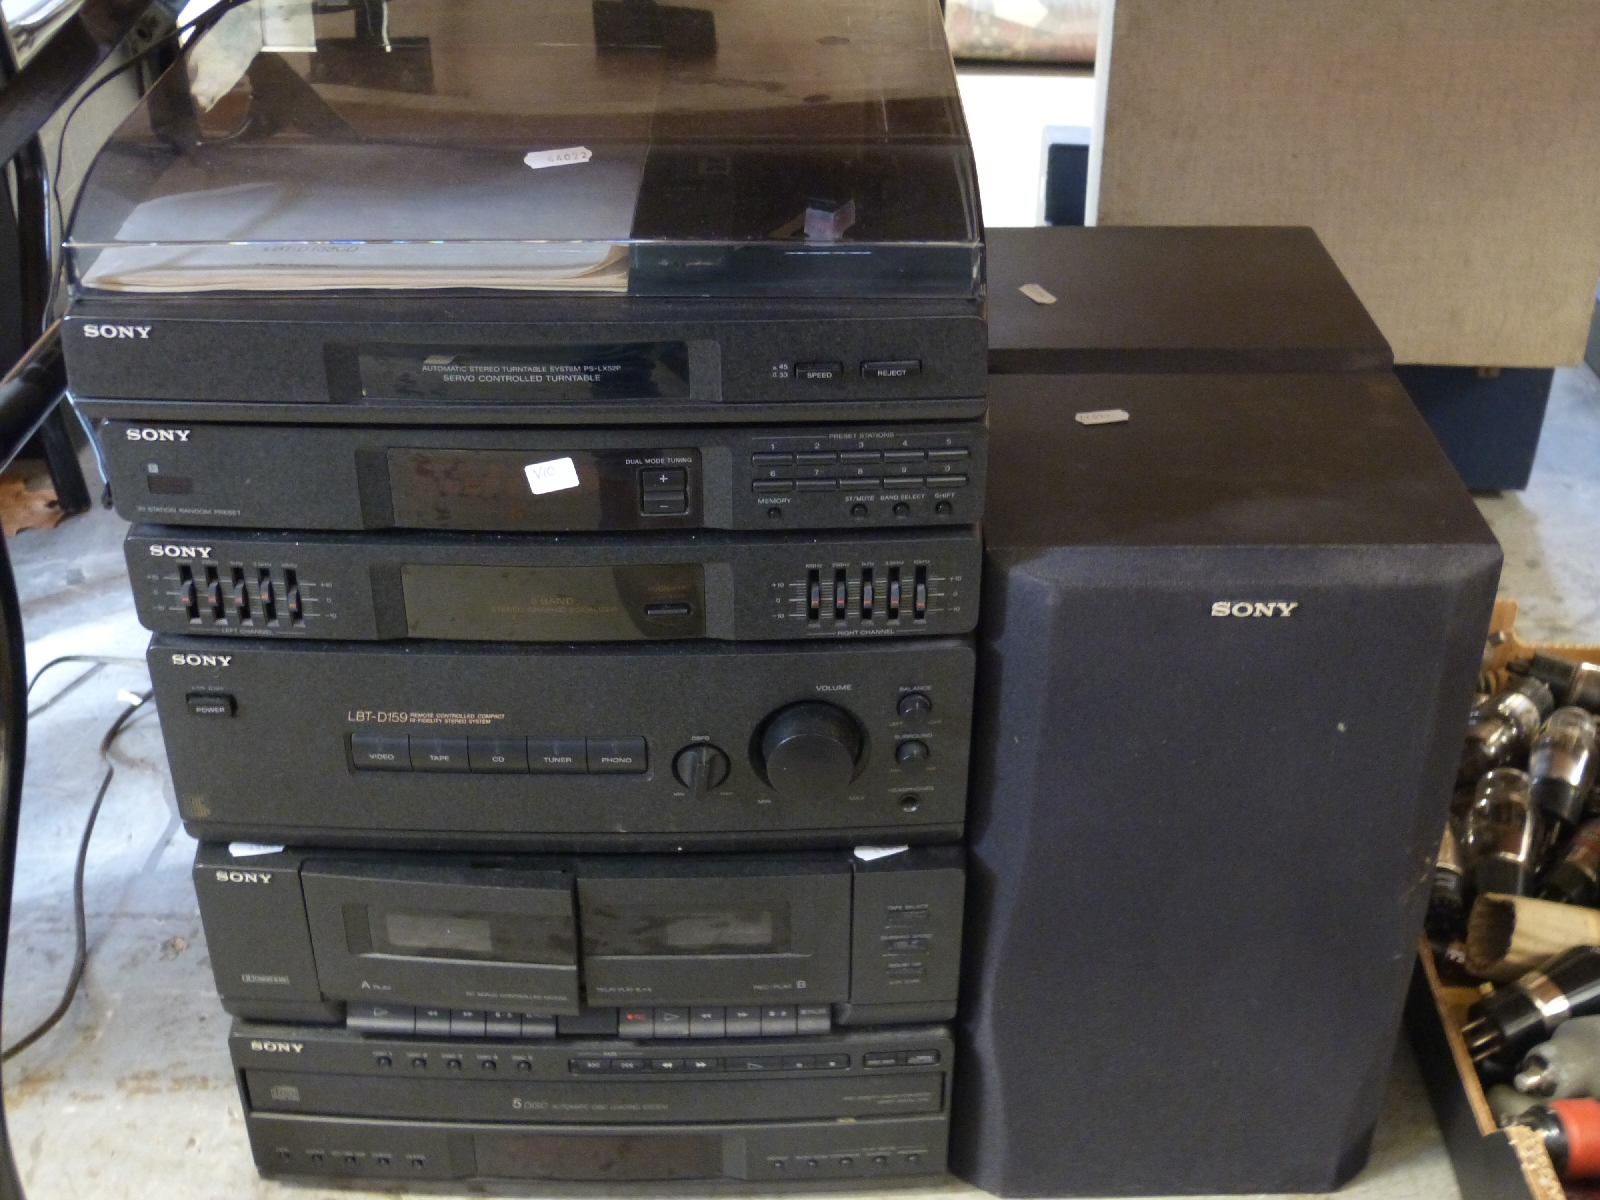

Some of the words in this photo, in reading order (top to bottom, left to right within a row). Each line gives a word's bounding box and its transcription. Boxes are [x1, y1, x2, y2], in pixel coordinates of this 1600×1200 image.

[547, 152, 588, 163] 44022
[83, 324, 151, 340] SONY
[422, 365, 467, 373] AUTOMATIC
[469, 365, 500, 373] STEREO
[501, 365, 547, 373] TURNTABLE
[549, 365, 581, 373] SYSTEM
[877, 369, 907, 377] REJECT
[443, 374, 476, 383] SERVO
[478, 374, 543, 383] CONTROLLED
[545, 374, 601, 382] TURNTABLE
[126, 429, 191, 442] SONY
[828, 432, 858, 440] PRESET
[859, 431, 895, 439] STATIONS
[644, 457, 665, 465] MODE
[757, 497, 792, 505] MEMORY
[149, 544, 212, 558] SONY
[1211, 601, 1299, 618] SONY
[837, 629, 859, 637] RIGHT
[172, 654, 232, 667] SONY
[815, 684, 853, 692] VOLUME
[196, 706, 225, 714] POWER
[348, 711, 408, 723] LBT-D159
[369, 753, 395, 761] VIDEO
[215, 870, 273, 884] SONY
[361, 980, 371, 990] A
[251, 1040, 304, 1054] SONY
[512, 1097, 522, 1109] 5
[523, 1101, 549, 1110] DISC
